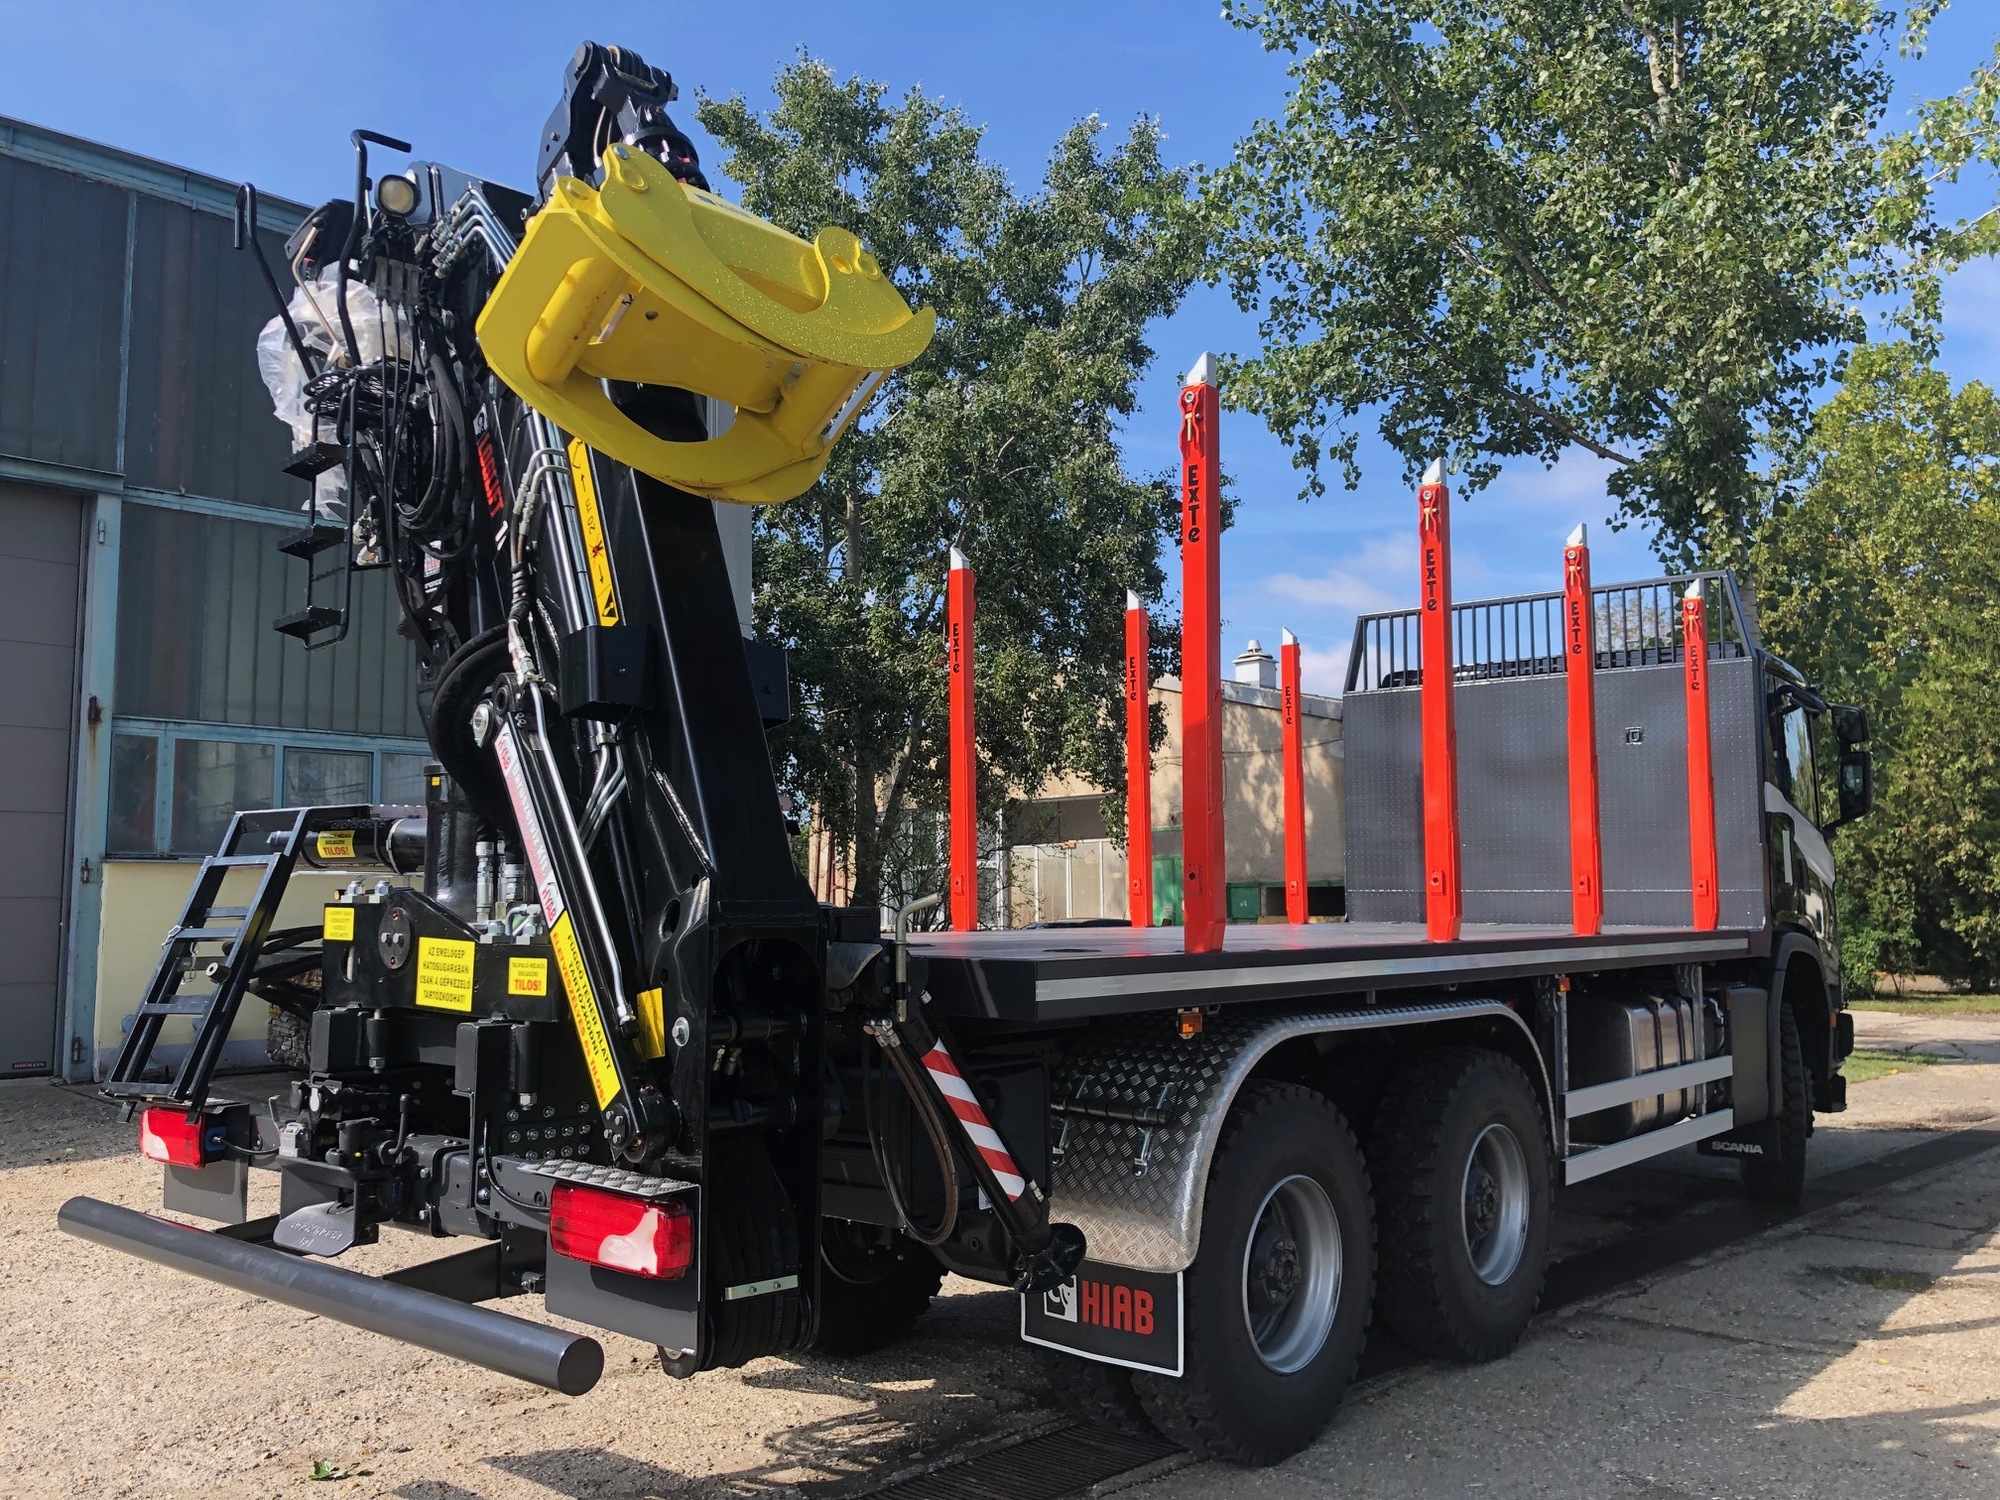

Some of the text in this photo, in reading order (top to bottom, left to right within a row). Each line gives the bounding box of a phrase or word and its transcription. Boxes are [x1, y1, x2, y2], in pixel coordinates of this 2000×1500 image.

[322, 846, 350, 856] TILOS!
[428, 946, 435, 957] AZ
[419, 974, 434, 985] CSAK
[514, 979, 542, 992] TILOS!
[581, 982, 597, 1026] TEHER
[596, 1030, 611, 1070] ALATT
[1711, 1140, 1764, 1155] SCANIA
[1081, 1279, 1155, 1335] HIAB
